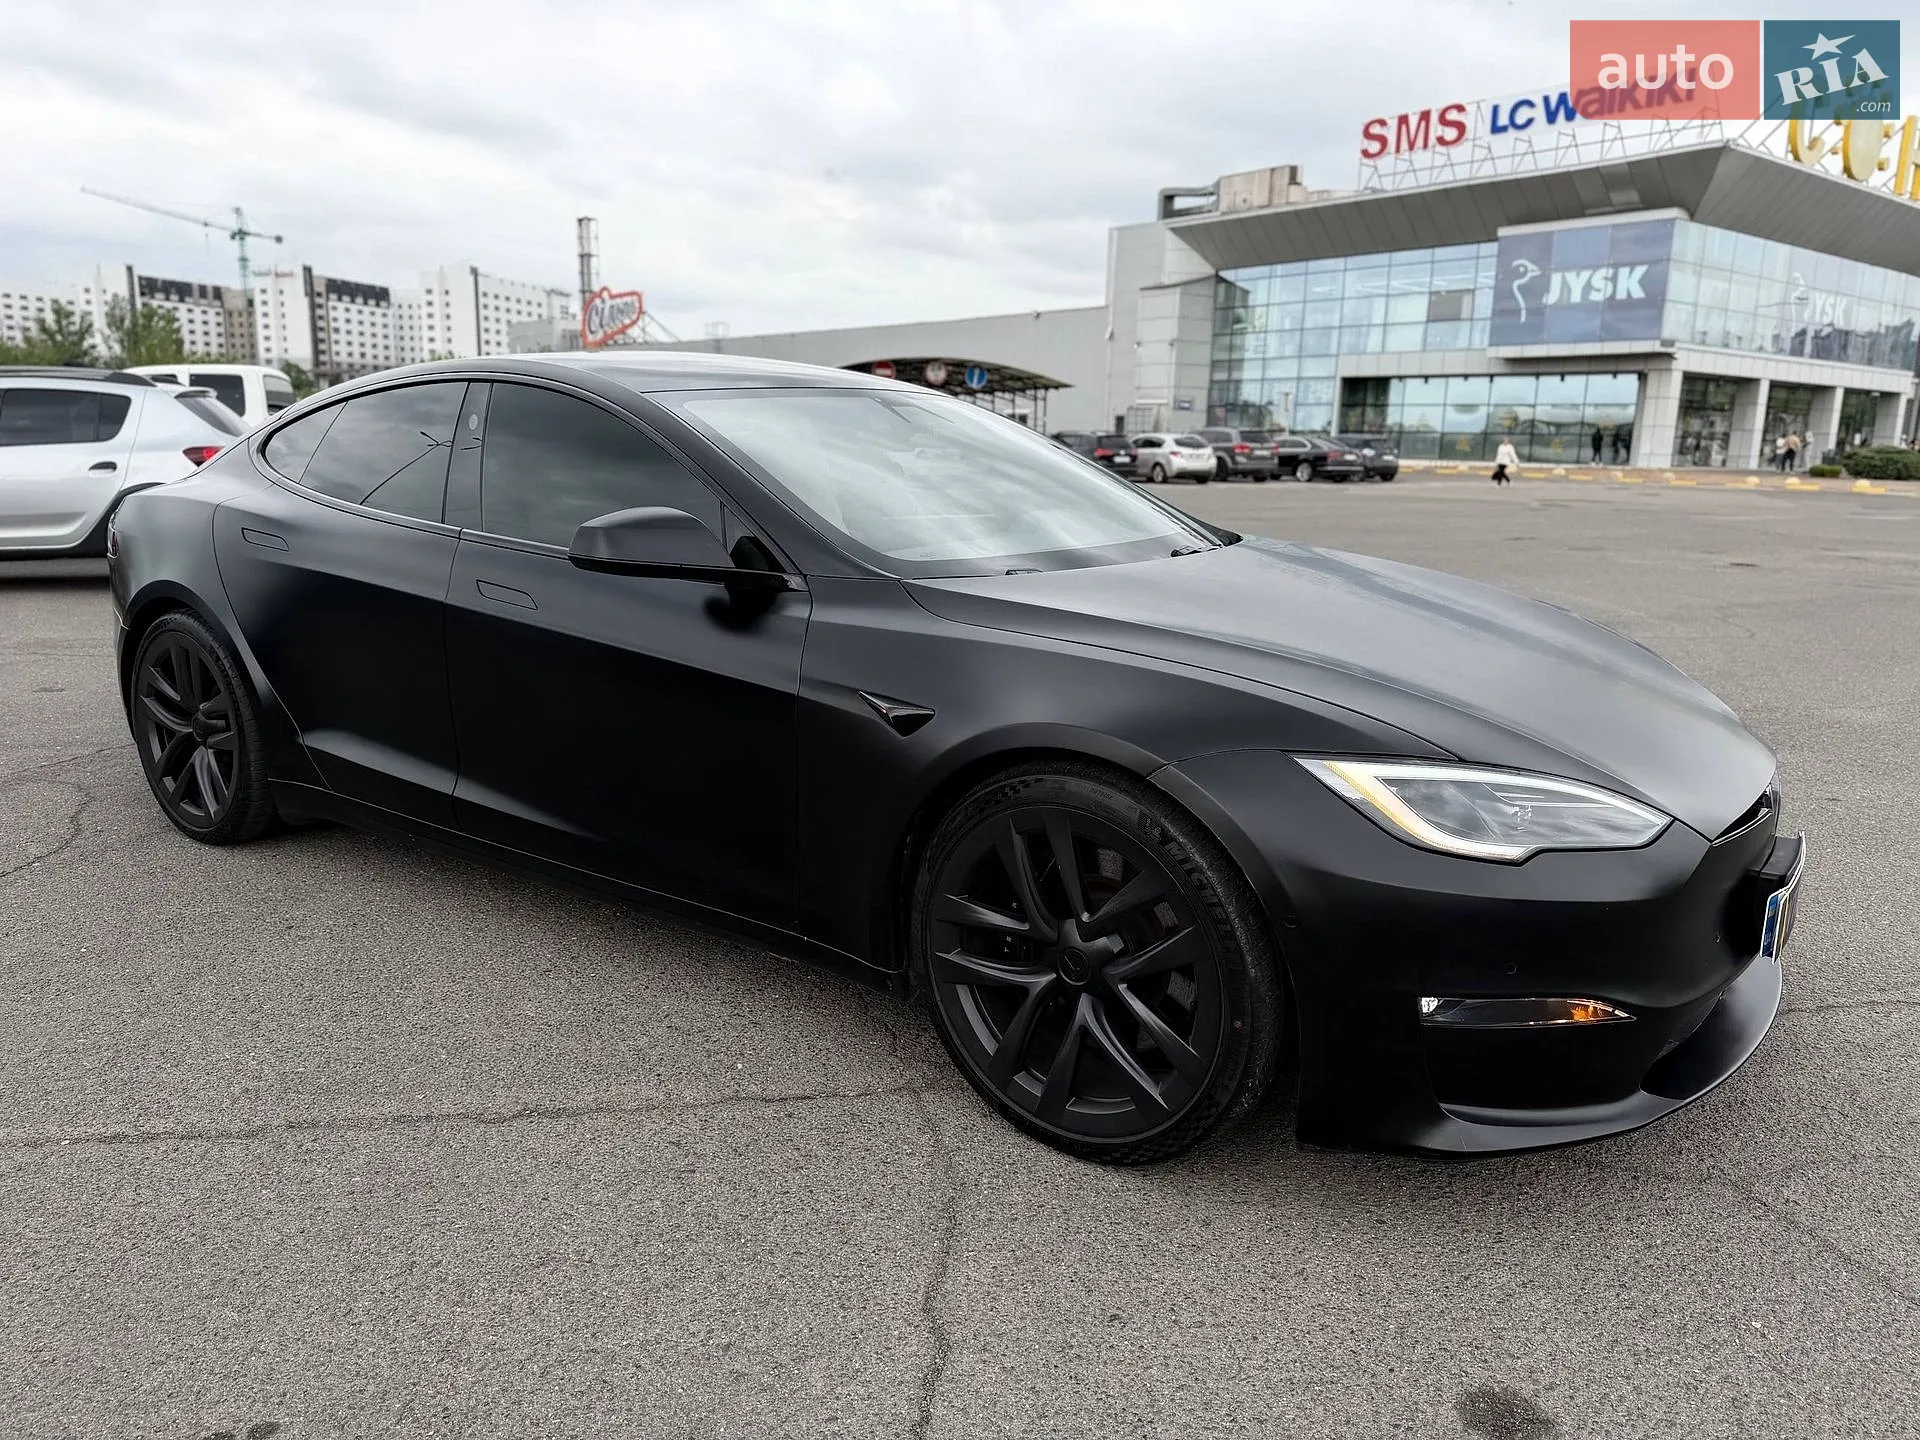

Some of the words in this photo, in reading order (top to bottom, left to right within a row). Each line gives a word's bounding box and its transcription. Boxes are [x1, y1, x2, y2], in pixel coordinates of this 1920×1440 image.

[1360, 103, 1468, 160] SMS
[1490, 98, 1537, 135] LC
[1542, 264, 1649, 306] JYSK
